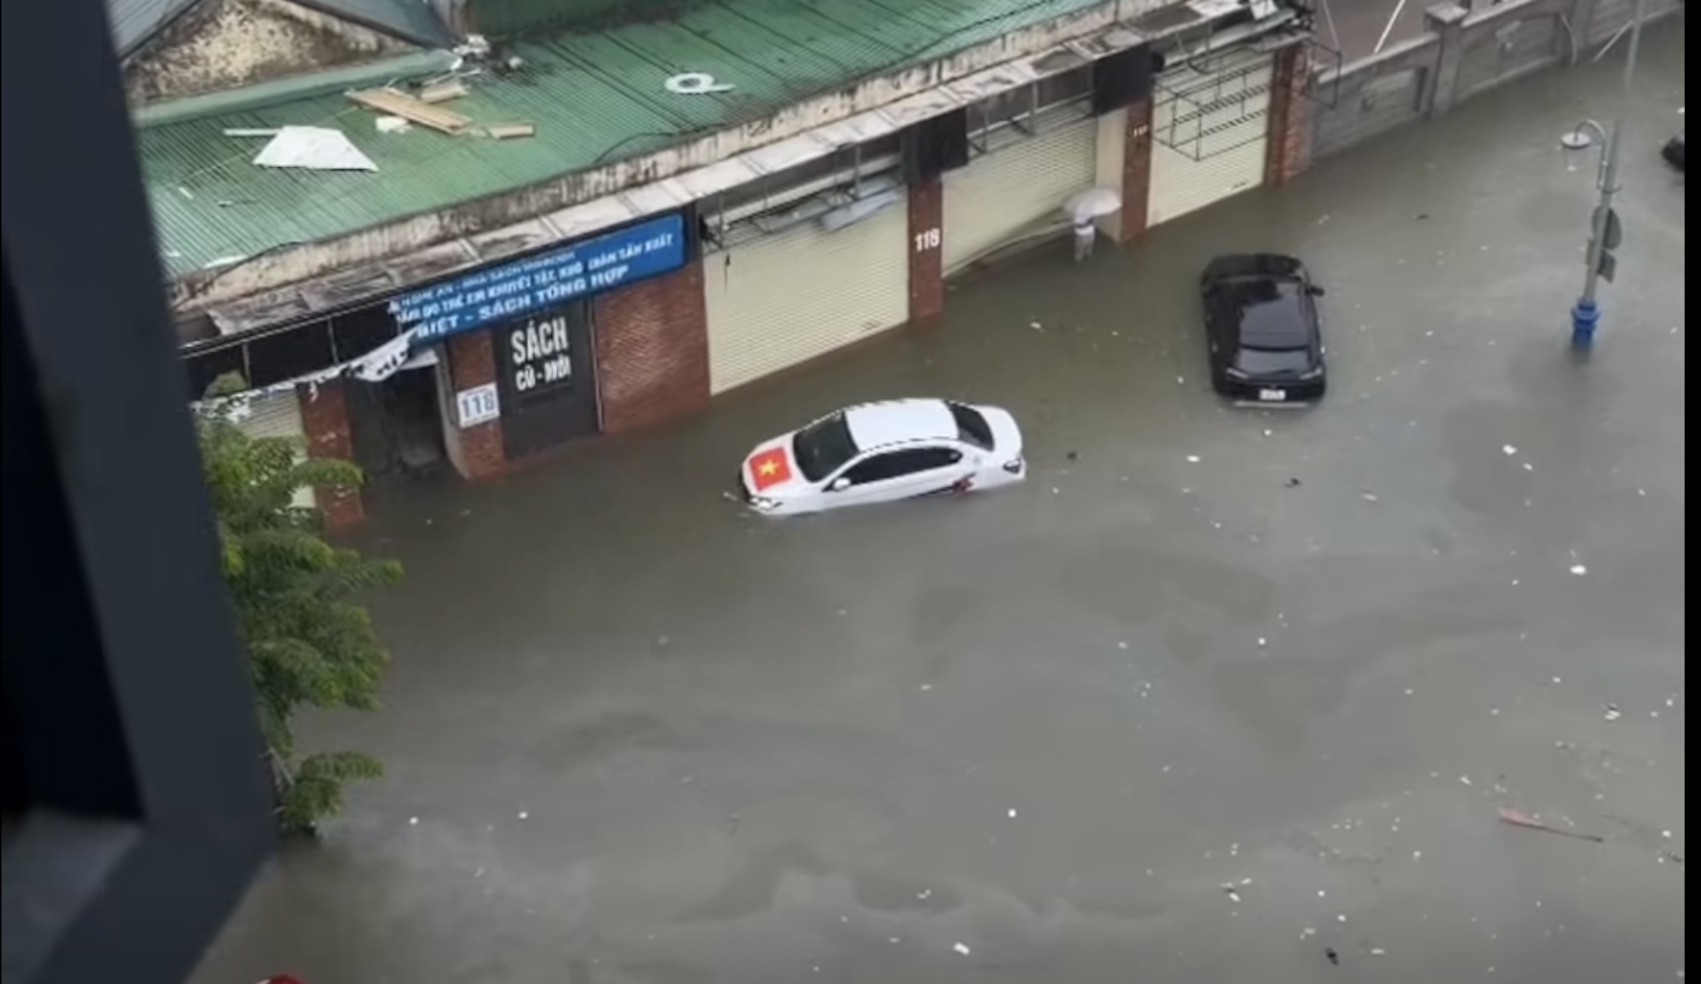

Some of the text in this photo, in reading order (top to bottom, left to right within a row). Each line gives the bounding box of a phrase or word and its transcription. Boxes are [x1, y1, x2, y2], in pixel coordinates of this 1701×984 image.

[914, 227, 940, 251] 118
[466, 289, 486, 305] EM
[479, 293, 531, 320] SÁCH
[536, 279, 586, 304] TỔNG
[590, 264, 630, 289] HỢP
[511, 317, 569, 365] SÁCH
[516, 364, 536, 392] CŨ
[462, 390, 496, 419] 118
